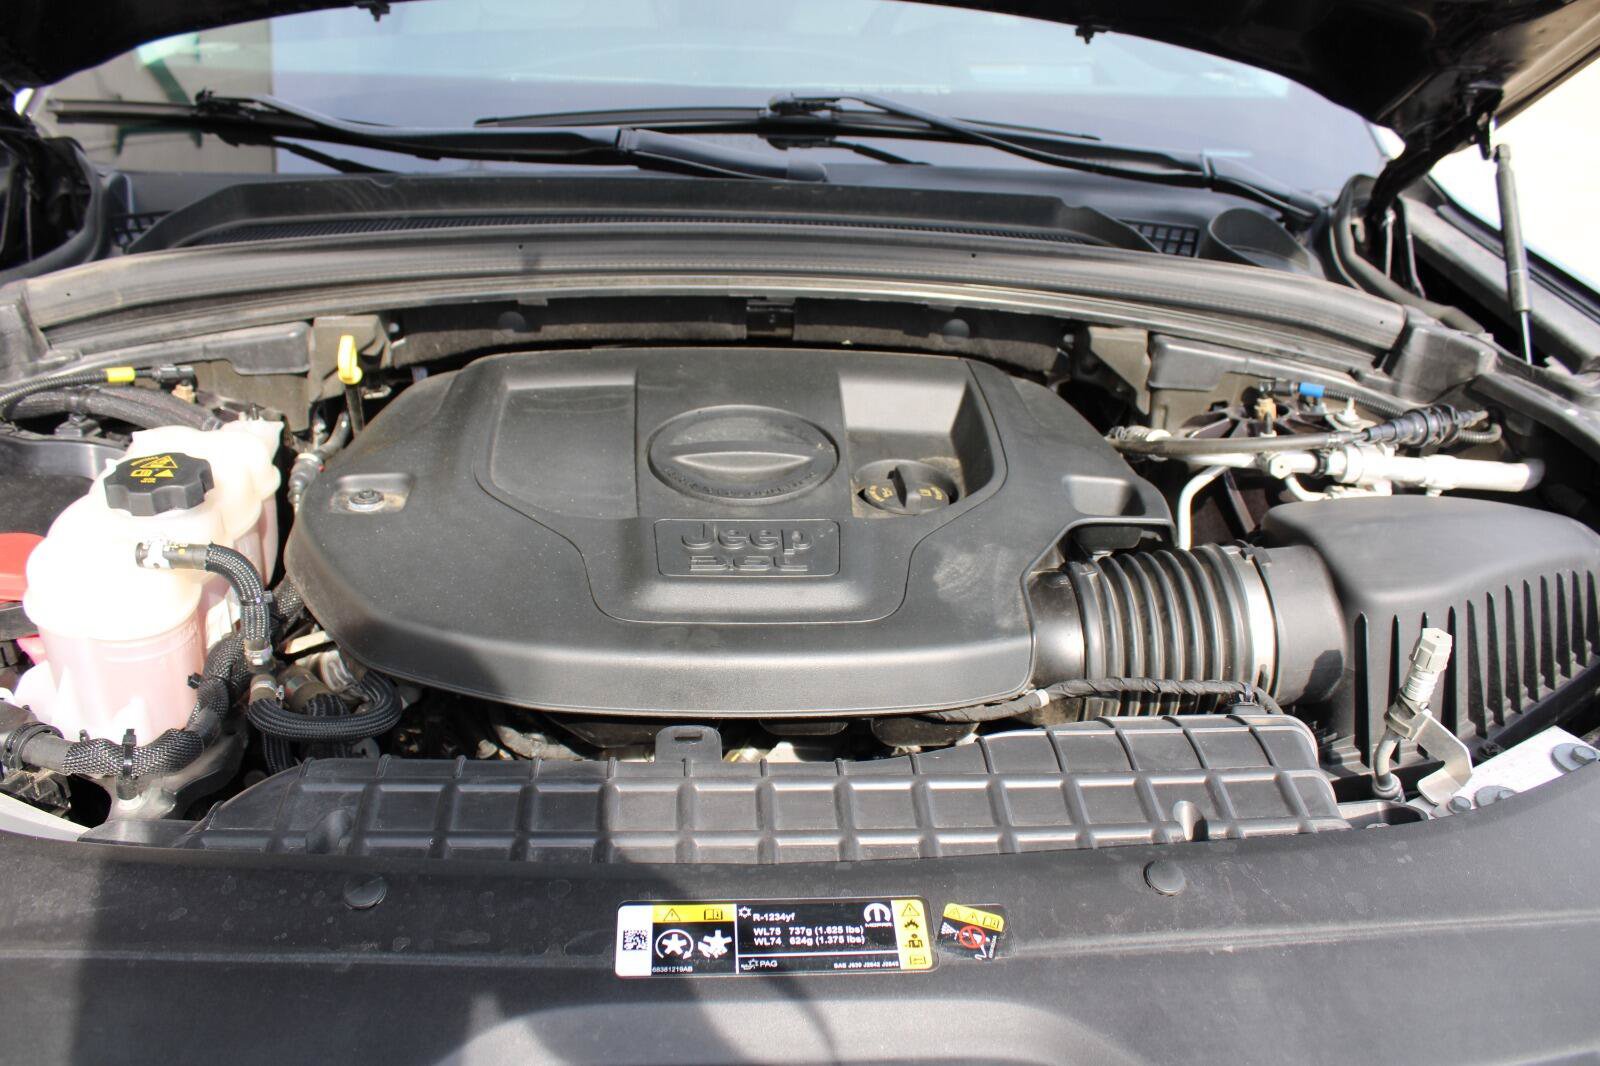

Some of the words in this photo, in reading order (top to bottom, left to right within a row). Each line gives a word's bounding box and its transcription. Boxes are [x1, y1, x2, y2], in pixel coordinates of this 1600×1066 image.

[681, 521, 814, 554] Jeep
[753, 912, 796, 922] R-1234yf
[789, 926, 813, 936] 737g
[814, 925, 843, 935] (1.625
[846, 925, 864, 935] lbs)
[754, 936, 782, 946] WL74
[789, 936, 813, 946] 624g
[815, 935, 844, 946] (1.375
[846, 935, 865, 945] lbs)
[760, 960, 778, 968] PAG
